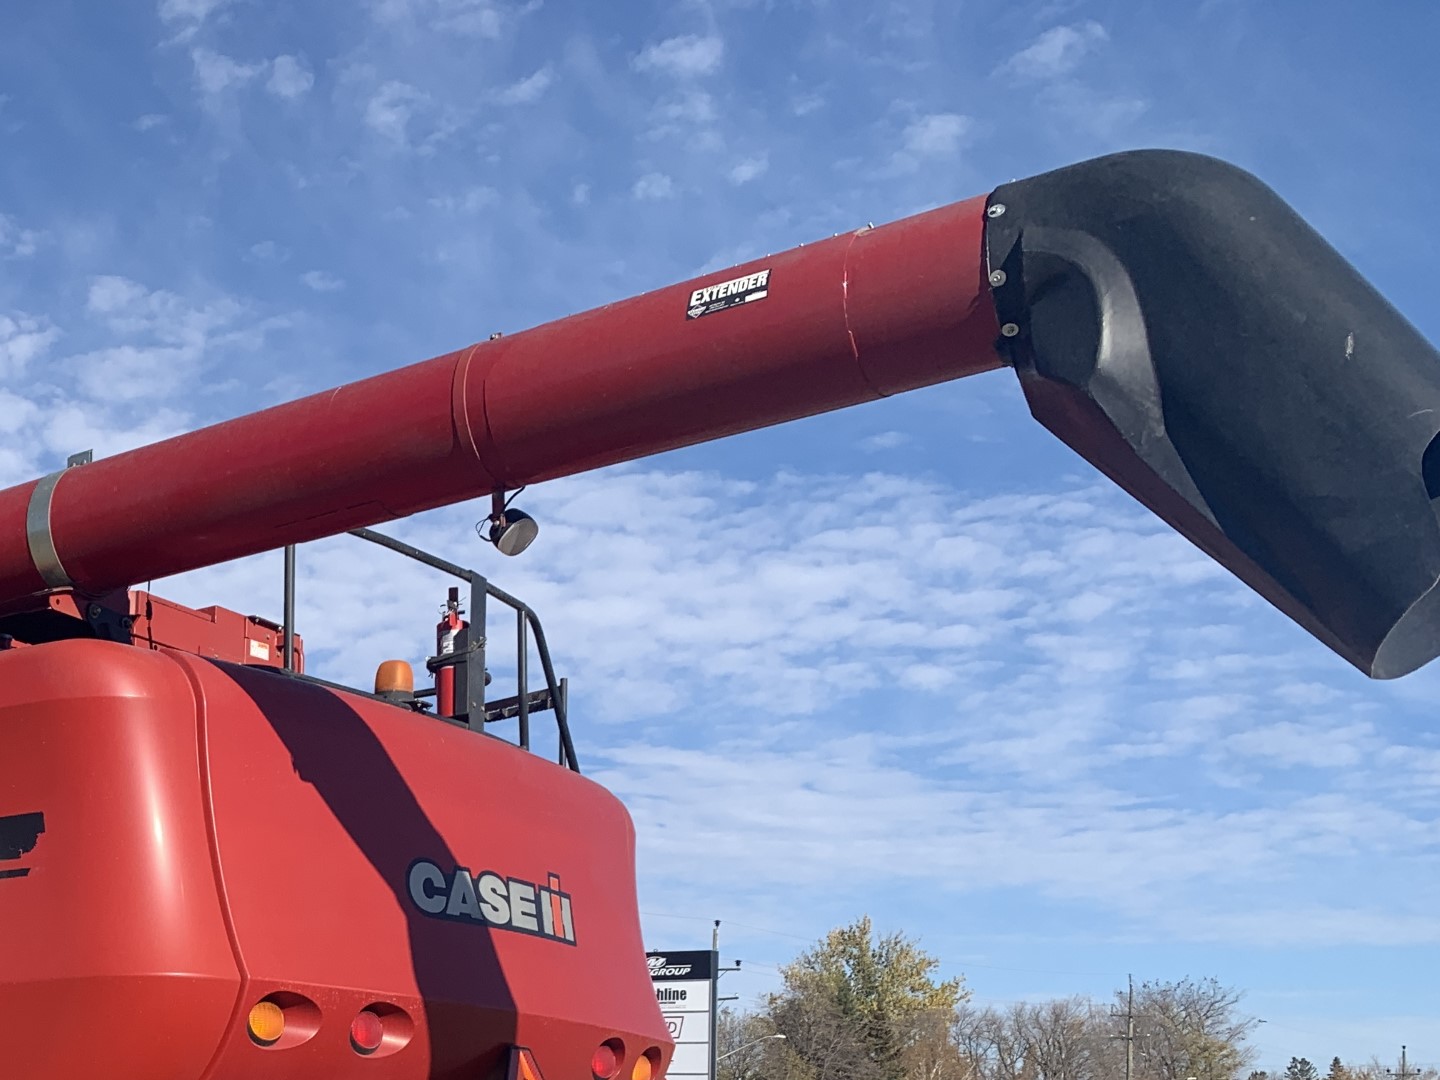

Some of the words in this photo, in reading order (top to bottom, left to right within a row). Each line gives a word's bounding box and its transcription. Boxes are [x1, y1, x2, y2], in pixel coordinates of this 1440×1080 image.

[689, 271, 770, 307] EXTENDER
[408, 861, 538, 931] CASE
[648, 967, 691, 976] GROUP
[657, 987, 687, 1001] hline
